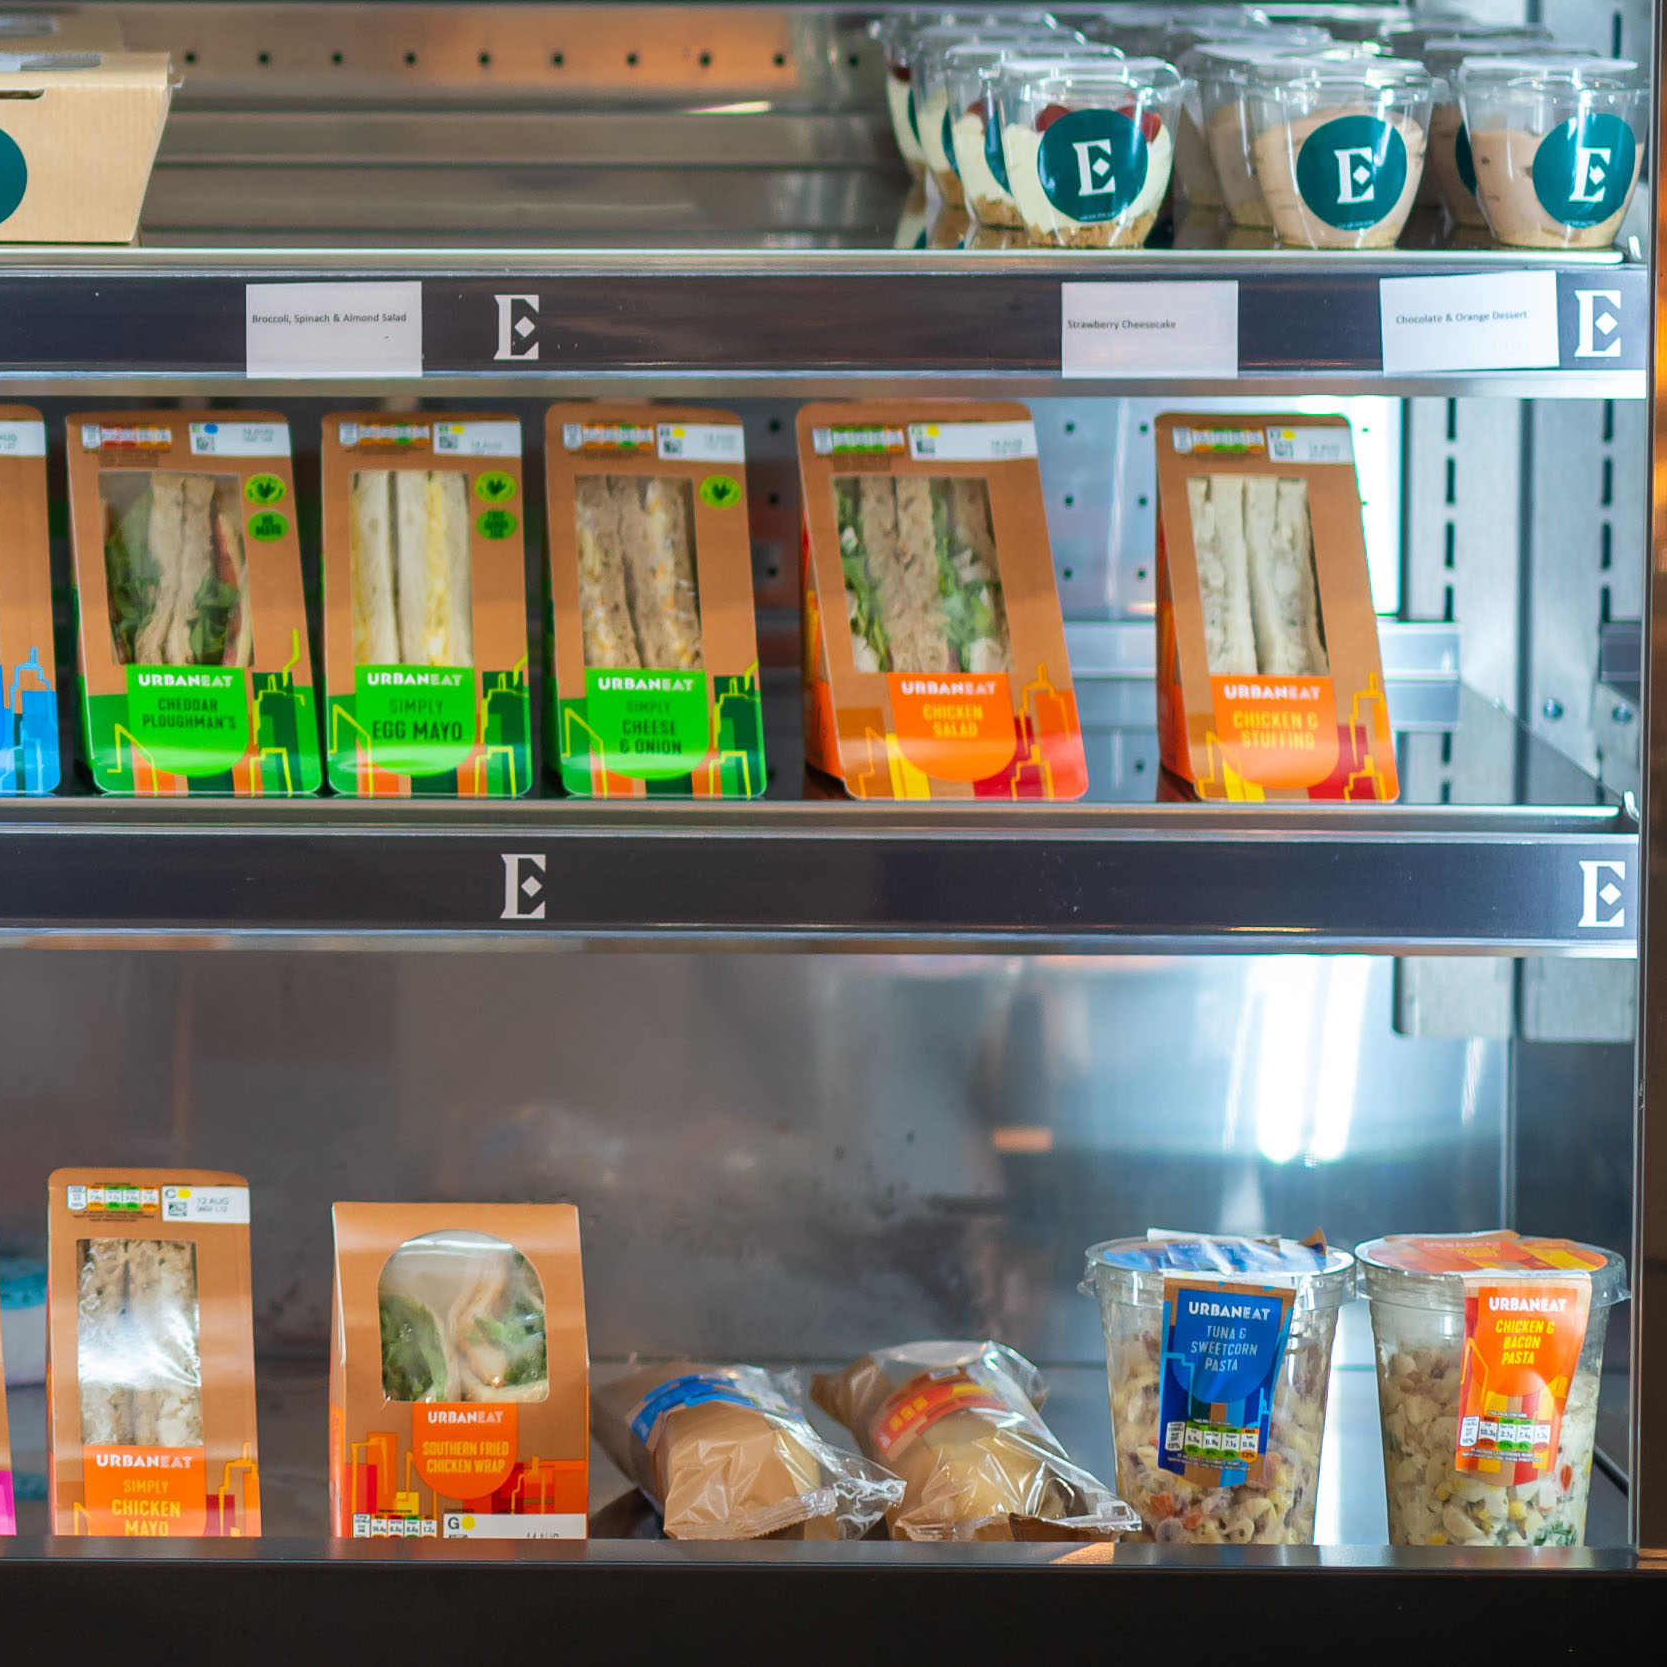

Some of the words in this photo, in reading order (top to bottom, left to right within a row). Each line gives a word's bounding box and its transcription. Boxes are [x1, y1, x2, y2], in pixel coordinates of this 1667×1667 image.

[1072, 139, 1116, 196] E
[251, 314, 293, 325] Broccoli,
[293, 313, 331, 325] Spinach
[332, 313, 341, 323] &
[342, 313, 380, 323] Almond
[381, 312, 408, 323] Salad
[1067, 319, 1120, 331] Strawberry
[1121, 319, 1177, 329] Cheesecake
[493, 294, 540, 360] E
[367, 673, 462, 686] URBANEAT
[389, 699, 443, 714] SIMPLY
[372, 721, 406, 739] EGG
[413, 722, 462, 741] MAYO
[1579, 861, 1625, 926] E
[1188, 1302, 1270, 1320] URBANEAT
[1206, 1326, 1235, 1340] TUNA
[1191, 1341, 1257, 1357] SWEETCORN
[1205, 1357, 1238, 1372] PASTA
[428, 1411, 503, 1423] URBANEAT
[426, 1458, 472, 1473] CHICKEN
[474, 1459, 506, 1473] WRAP
